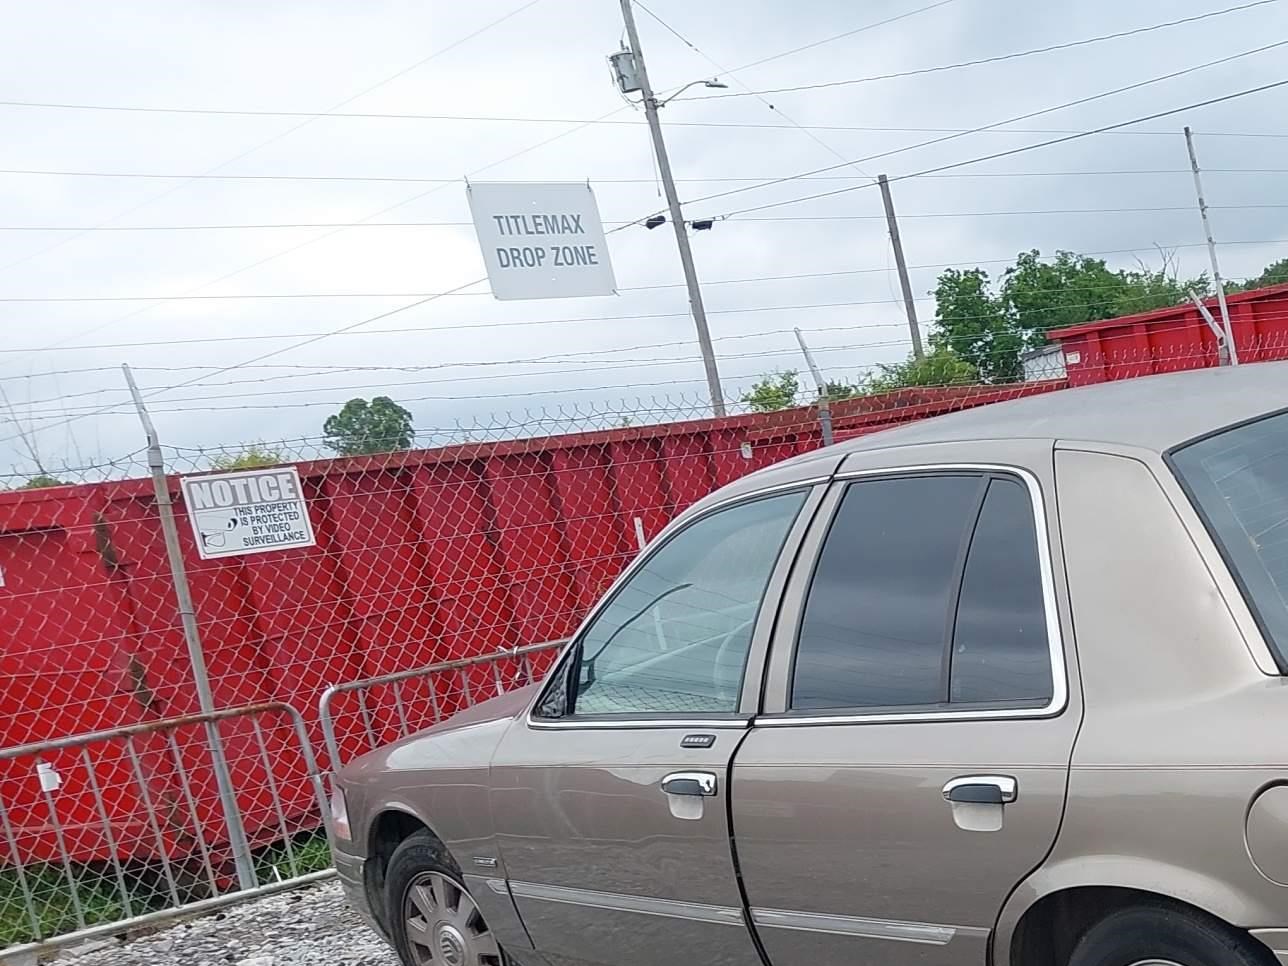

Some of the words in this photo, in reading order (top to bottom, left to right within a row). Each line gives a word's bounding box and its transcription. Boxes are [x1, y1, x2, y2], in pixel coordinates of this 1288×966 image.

[493, 214, 585, 235] TITLEMAX
[496, 247, 546, 268] DROP
[550, 245, 599, 266] ZONE
[190, 474, 296, 508] NOTICE
[233, 505, 253, 517] THIS
[254, 501, 298, 514] PROPERTY
[239, 517, 249, 526] IS
[250, 511, 300, 525] PROTECTED
[252, 524, 266, 534] BY
[267, 522, 291, 532] VIDEO
[242, 530, 306, 547] SURVEILLANCE
